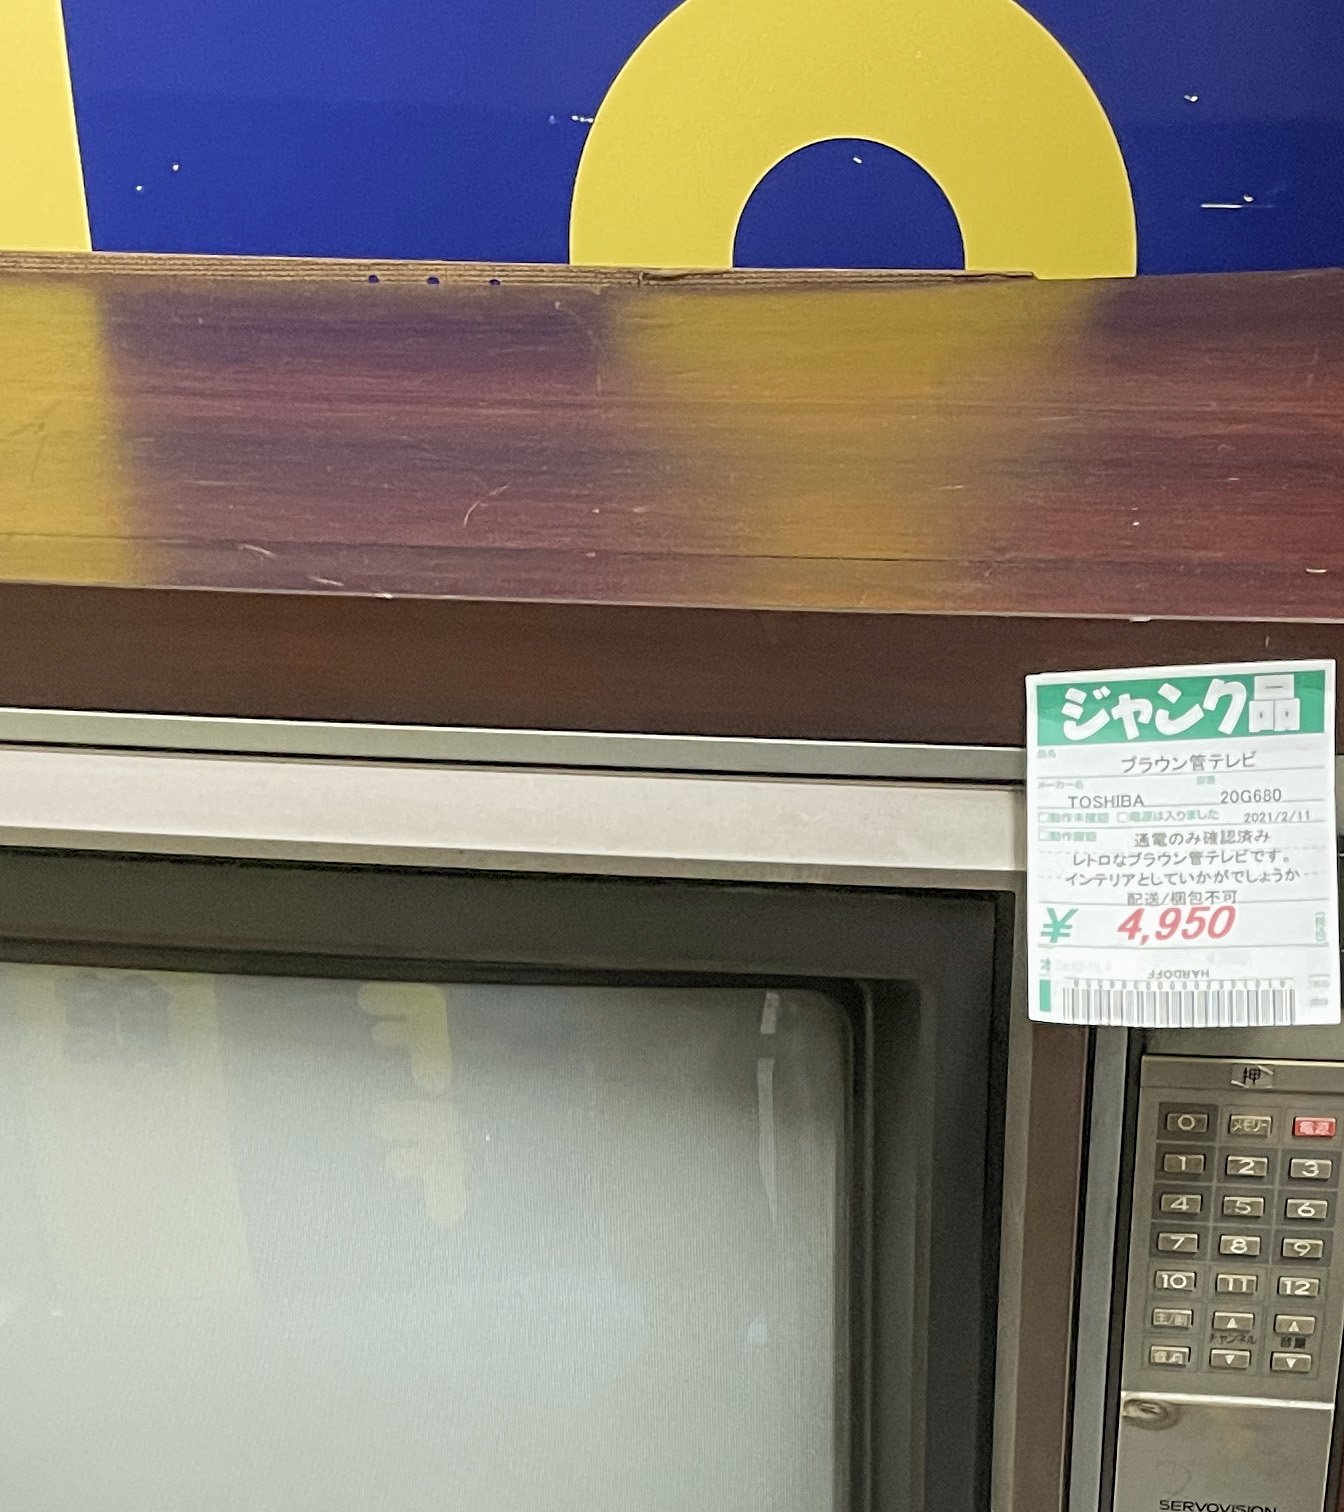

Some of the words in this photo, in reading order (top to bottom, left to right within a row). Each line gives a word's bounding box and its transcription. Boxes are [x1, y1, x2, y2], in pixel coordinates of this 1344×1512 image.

[1062, 674, 1300, 741] ジャンク品
[1121, 750, 1256, 774] ブラウン管テレビ
[1068, 794, 1145, 809] TOSHIBA
[1220, 788, 1282, 804] 20G680
[1244, 810, 1311, 825] 2021/2/11
[1134, 830, 1270, 849] 通電のみ確認済み
[1073, 848, 1290, 868] レトロなブラウン管テレビです。
[1065, 868, 1300, 888] インテリアとしていかがでしょうか
[1127, 890, 1237, 906] 配送/梱包不可
[1117, 904, 1237, 945] 4,950
[1146, 968, 1210, 979] HARDOFF
[1177, 1114, 1196, 1131] 0
[1177, 1156, 1187, 1172] 1
[1237, 1159, 1255, 1175] 2
[1301, 1160, 1319, 1177] 3
[1170, 1195, 1190, 1212] 4
[1234, 1199, 1252, 1215] 5
[1297, 1201, 1316, 1218] 6
[1170, 1236, 1187, 1250] 7
[1229, 1238, 1248, 1254] 8
[1293, 1240, 1311, 1257] 9
[1161, 1273, 1188, 1289] 10
[1226, 1277, 1248, 1292] 11
[1284, 1280, 1312, 1295] 12
[1208, 1333, 1257, 1345] チャンネル
